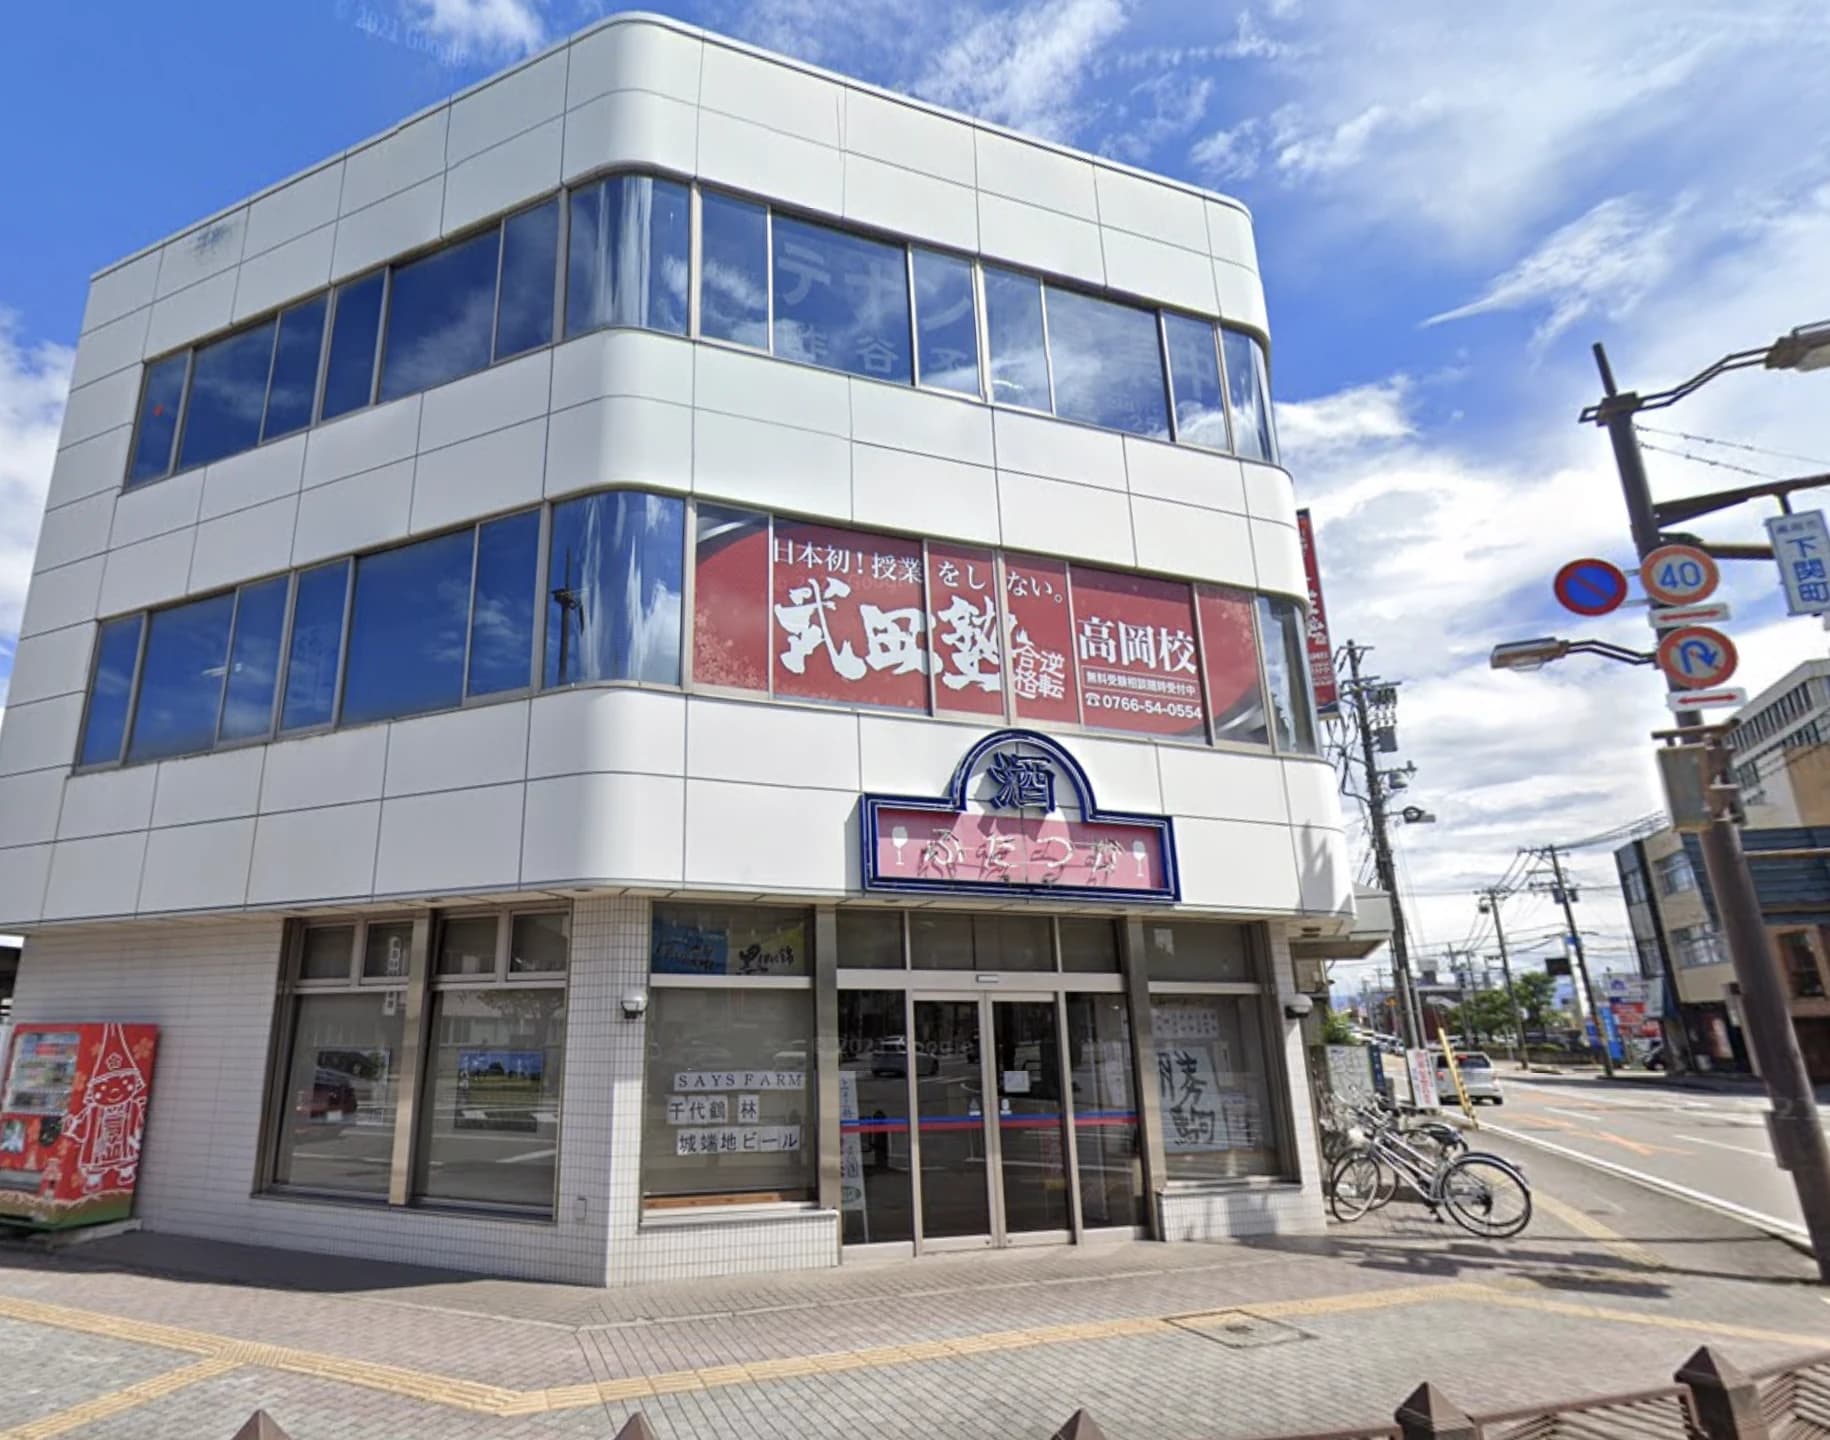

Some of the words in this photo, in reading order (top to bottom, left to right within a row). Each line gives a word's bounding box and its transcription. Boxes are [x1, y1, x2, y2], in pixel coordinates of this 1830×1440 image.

[1660, 562, 1700, 589] 40
[774, 577, 1033, 692] 武田塾
[1077, 616, 1197, 674] 高岡校
[1102, 694, 1202, 720] 0766-54-0554
[986, 751, 1055, 813] 酒
[678, 1074, 736, 1088] SAYS
[744, 1073, 803, 1087] FARM
[668, 1101, 727, 1122] 千代鶴
[740, 1101, 758, 1120] 林
[679, 1131, 799, 1153] 城端地ビール
